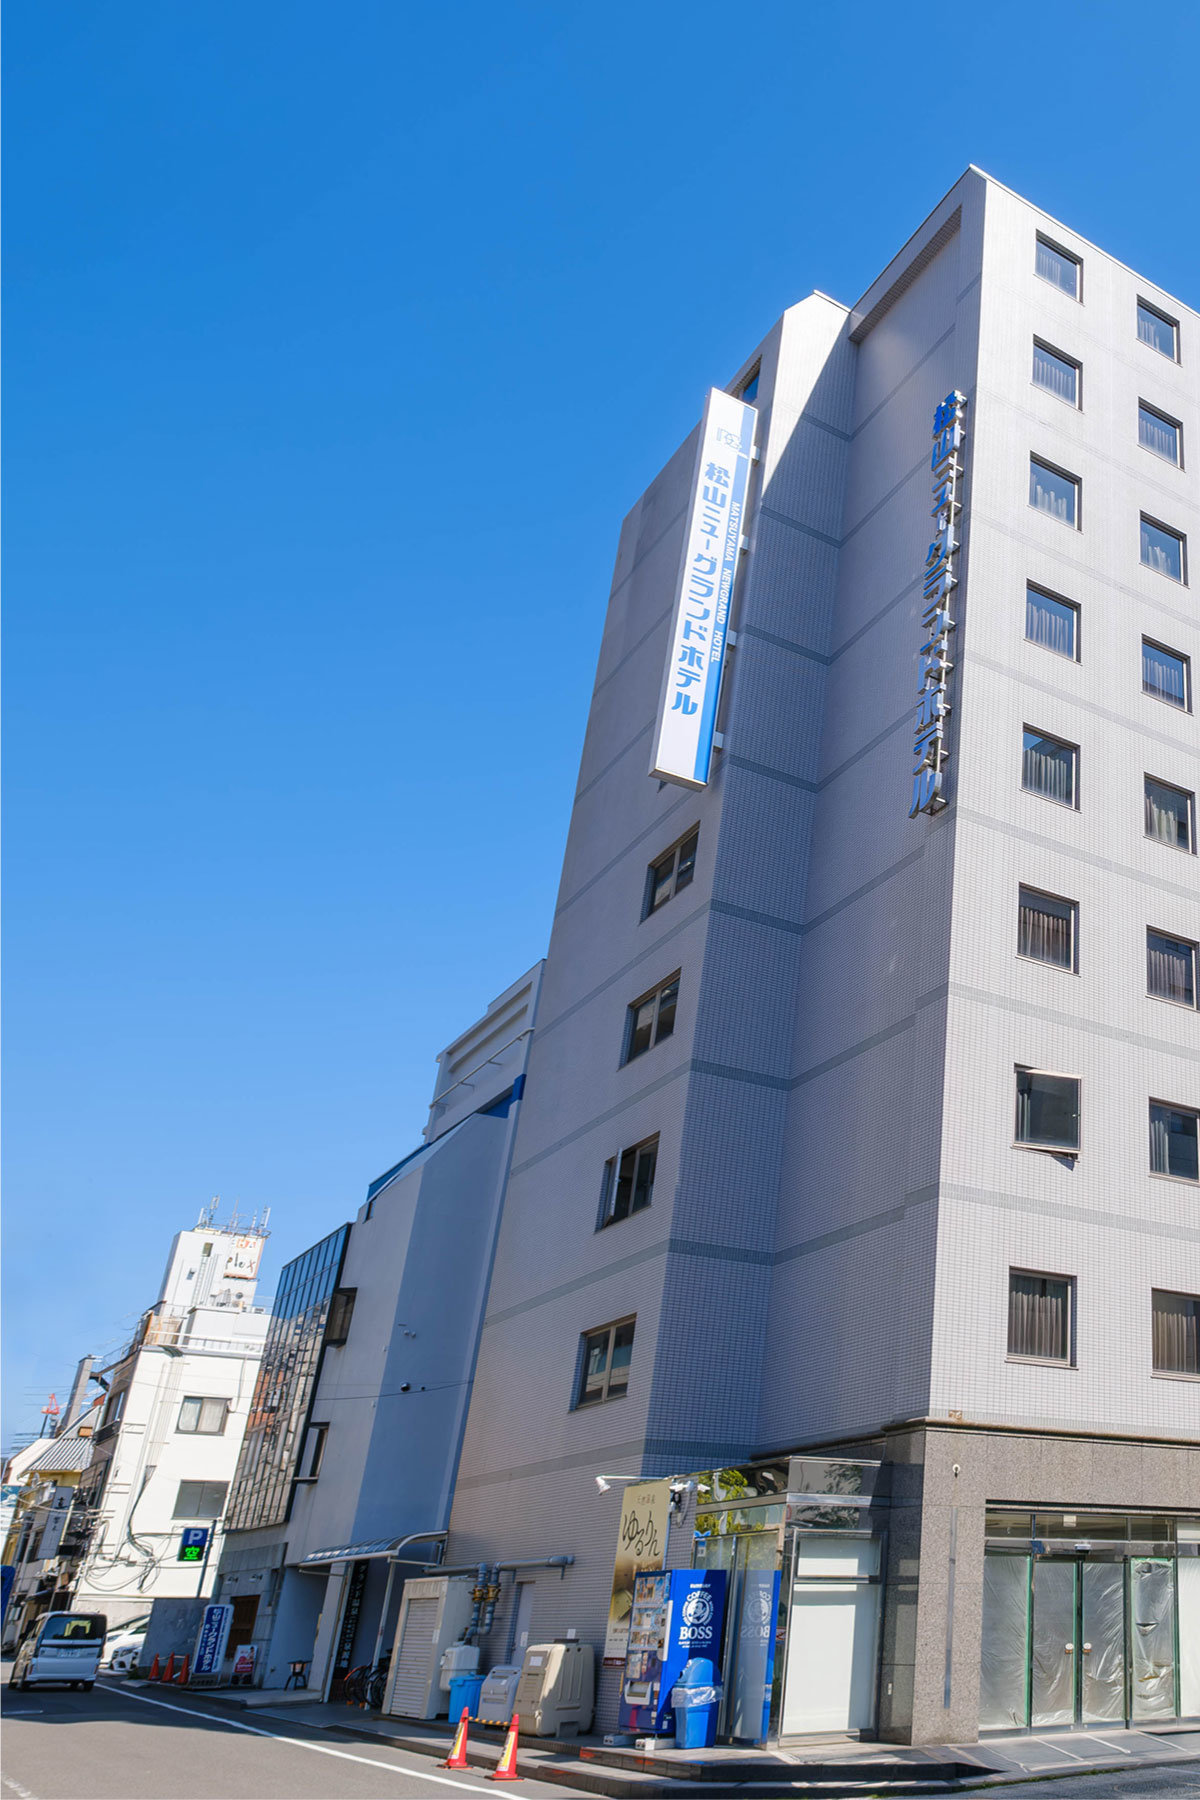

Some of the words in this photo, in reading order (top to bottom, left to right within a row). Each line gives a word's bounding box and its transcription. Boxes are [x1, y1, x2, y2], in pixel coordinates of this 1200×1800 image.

[725, 501, 740, 562] MATSUYAMA
[671, 462, 730, 716] 松山ニューグランドホテル
[717, 568, 732, 624] NEWGRAND
[909, 390, 965, 819] 松山ニューグランドホテル
[711, 630, 724, 662] HOTEL
[188, 1530, 203, 1544] P
[623, 1510, 660, 1556] ゆるりん
[184, 1546, 200, 1560] 空
[687, 1590, 712, 1601] COFFEE
[679, 1626, 713, 1640] BOSS
